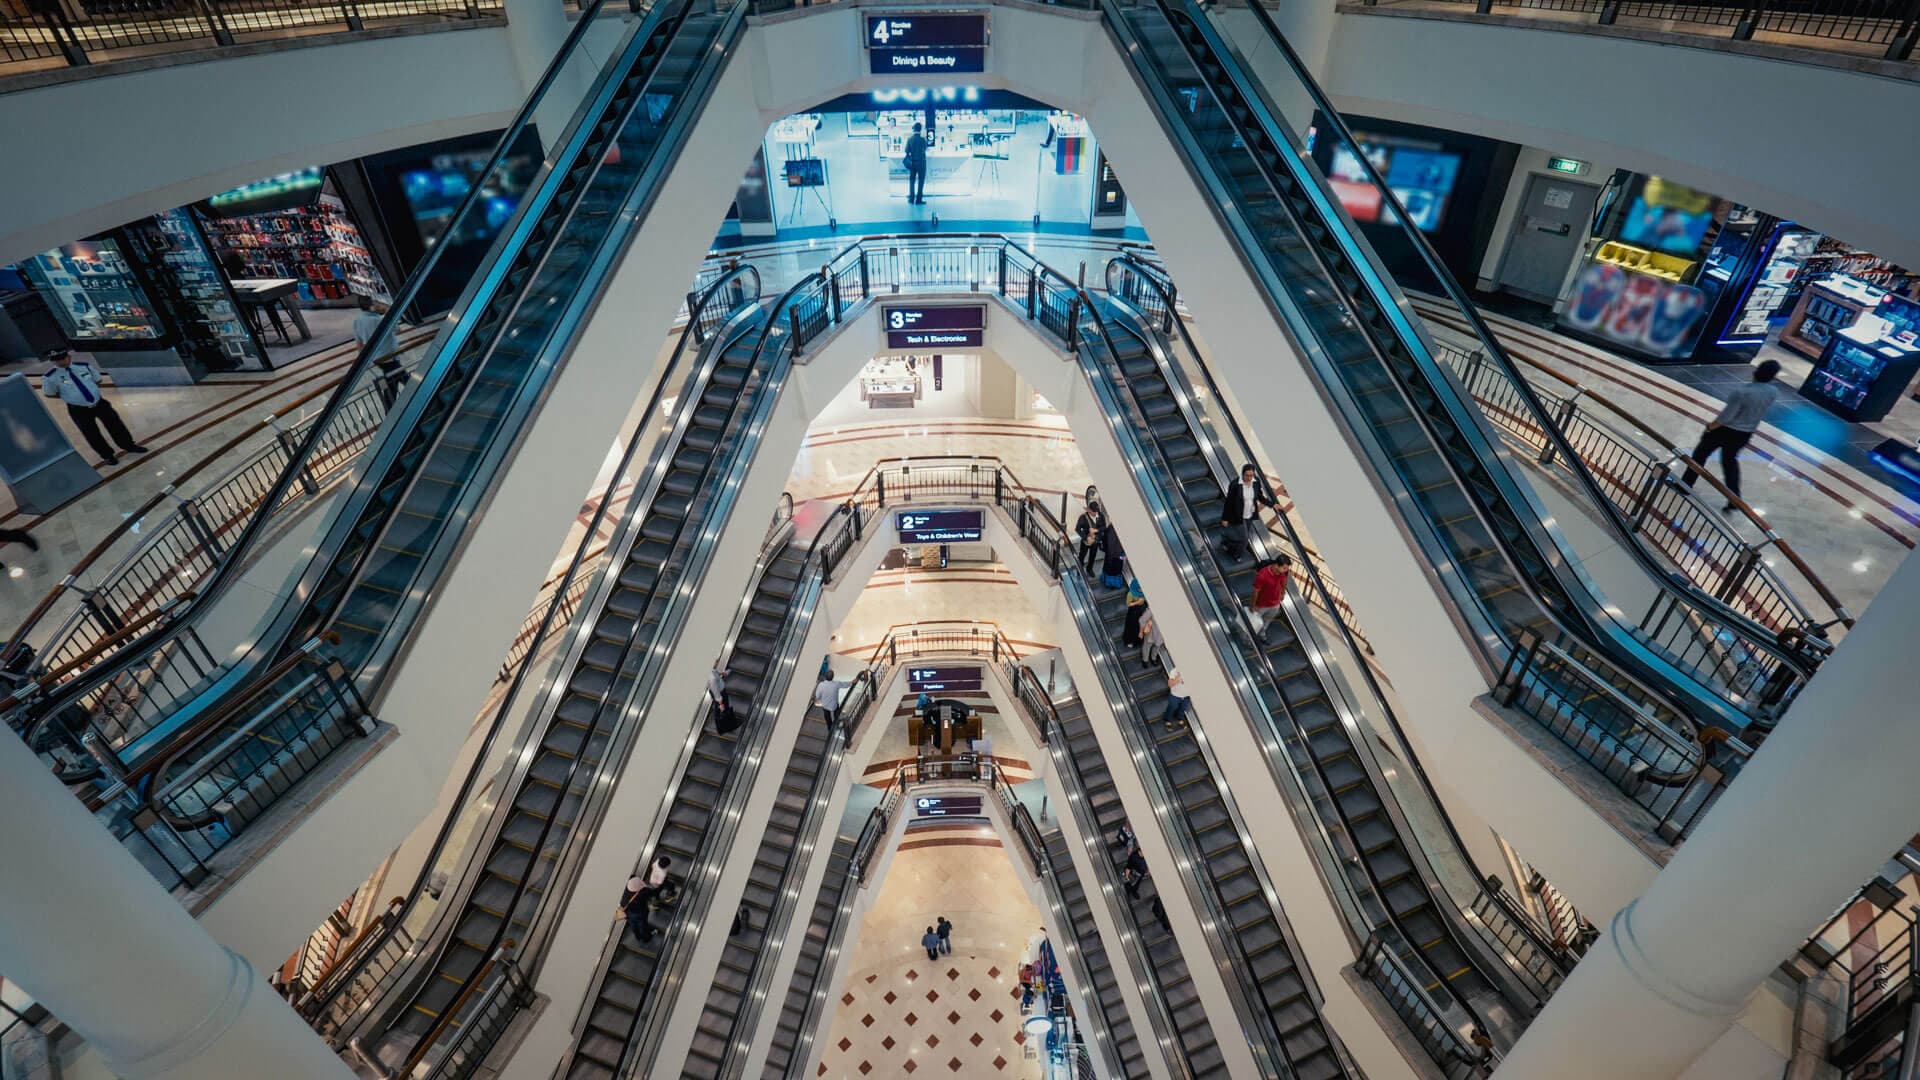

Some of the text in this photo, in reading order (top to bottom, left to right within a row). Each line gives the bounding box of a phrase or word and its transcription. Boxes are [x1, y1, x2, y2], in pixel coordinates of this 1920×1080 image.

[874, 20, 889, 44] 4
[892, 56, 956, 67] Dining & Beauty
[927, 131, 934, 141] 3
[891, 311, 904, 328] 3
[906, 336, 923, 344] Tech
[931, 335, 967, 343] Electronics
[903, 516, 914, 529] 2
[913, 670, 920, 680] 1
[919, 799, 929, 808] G
